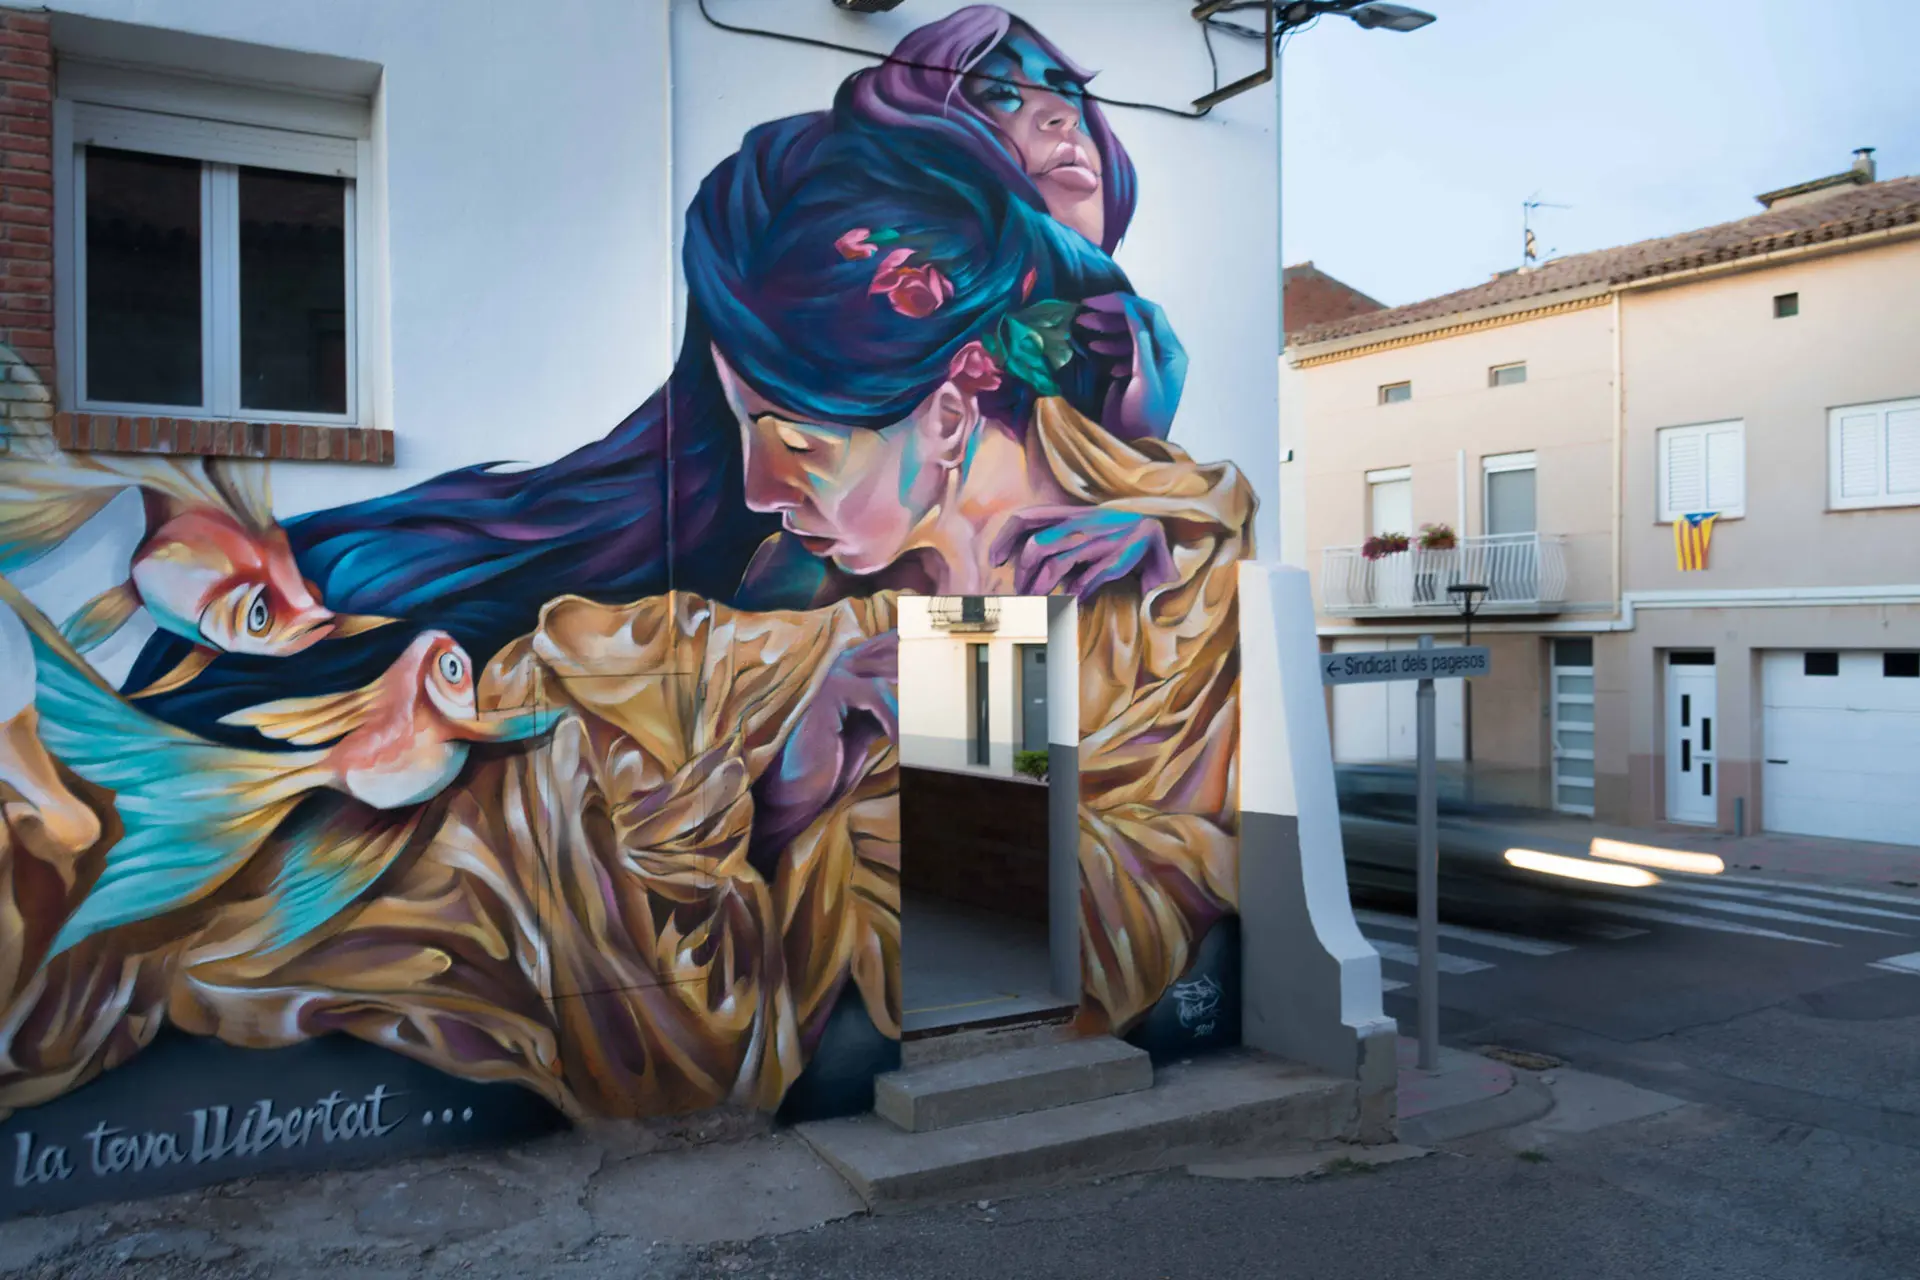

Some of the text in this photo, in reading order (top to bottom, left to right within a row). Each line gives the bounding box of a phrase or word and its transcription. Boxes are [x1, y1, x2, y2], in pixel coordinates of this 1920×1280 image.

[1344, 653, 1485, 676] Sindicat dels pagesos
[83, 1119, 189, 1177] teva
